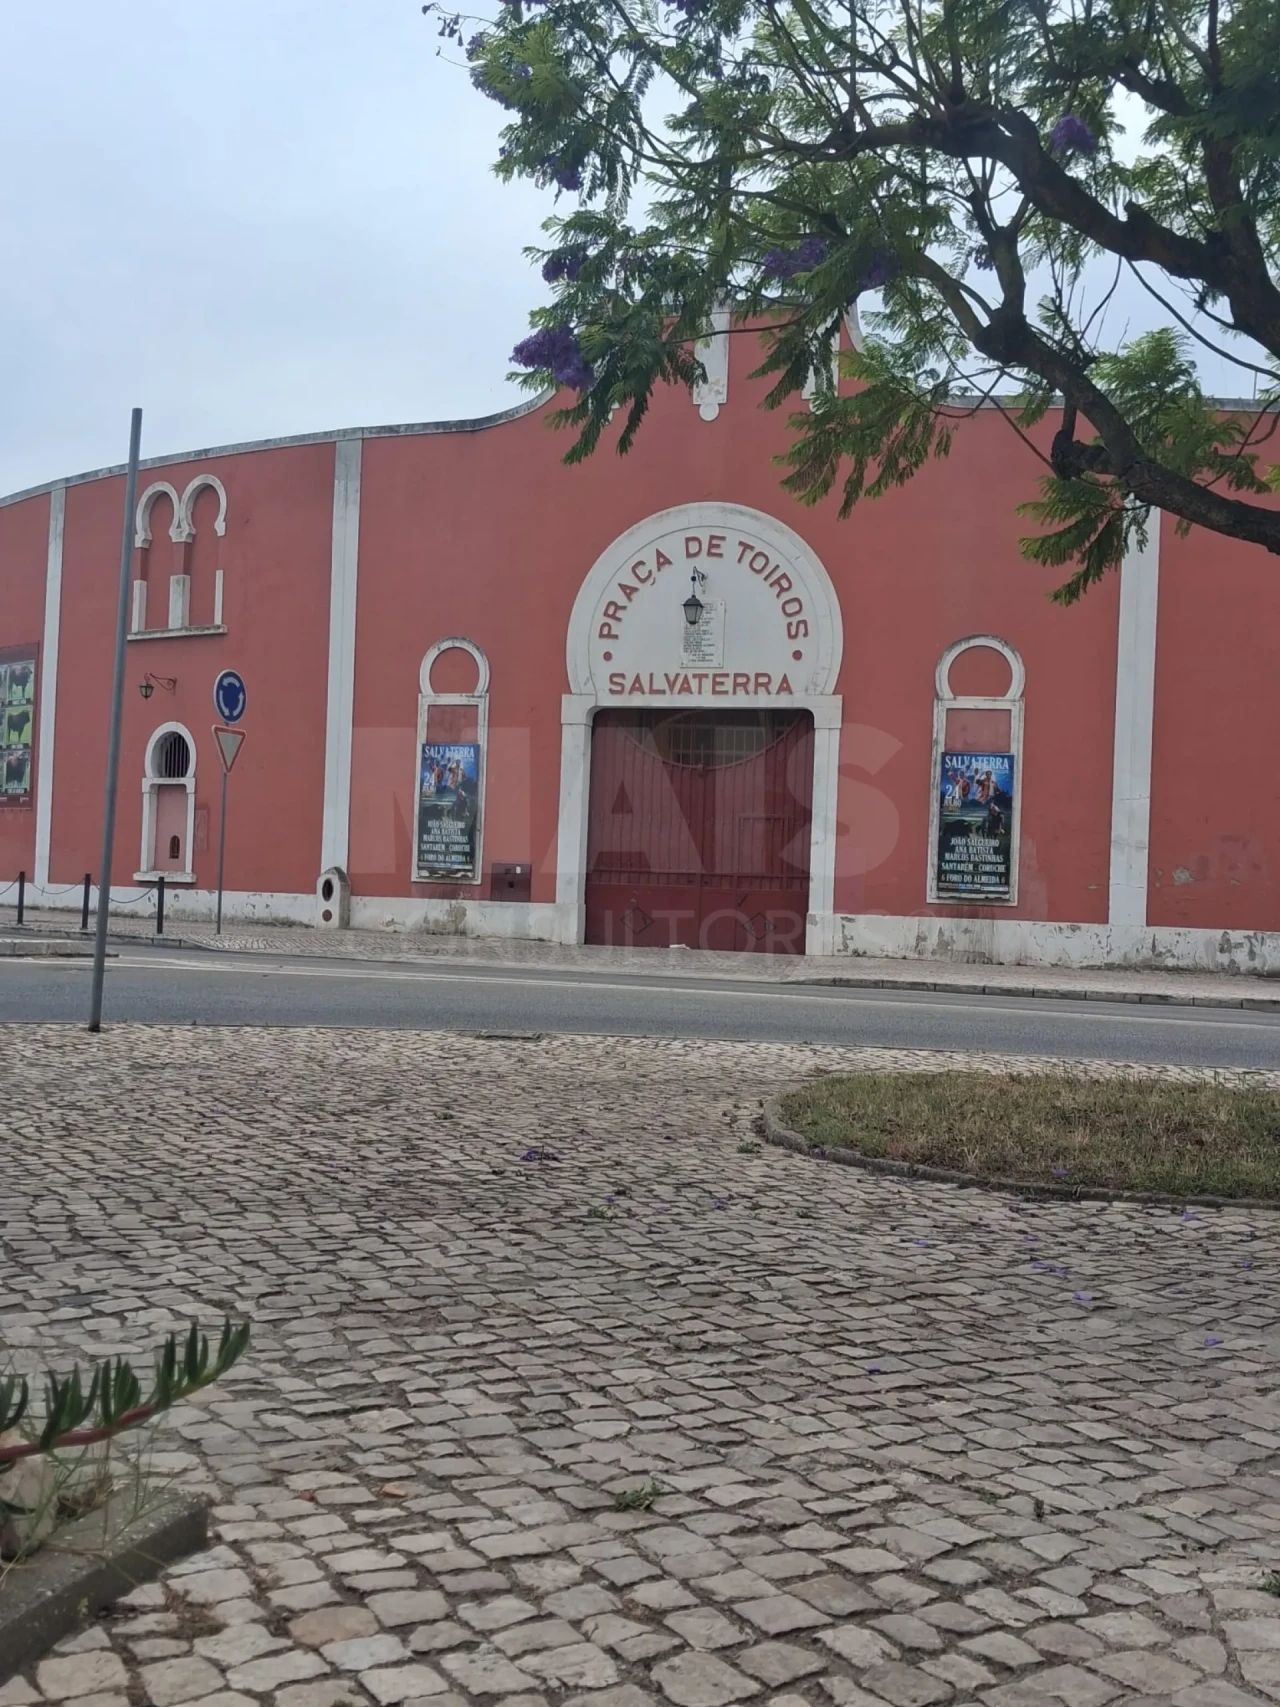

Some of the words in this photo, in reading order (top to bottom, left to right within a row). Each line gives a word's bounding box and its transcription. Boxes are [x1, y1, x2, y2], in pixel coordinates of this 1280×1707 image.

[599, 548, 673, 640] PRAÇA
[685, 534, 726, 559] DE
[737, 541, 809, 640] TOIROS
[608, 672, 793, 696] SALVATERRA
[424, 745, 475, 758] SALVATERRA
[945, 755, 1009, 769] SALVATERRA
[424, 772, 436, 787] 24
[945, 784, 959, 799] 24
[955, 846, 967, 854] ANA
[944, 853, 969, 861] MARCOS
[970, 854, 1004, 863] BASTINHAS
[978, 864, 1007, 873] CORUCHE
[946, 874, 962, 882] FORO
[963, 874, 972, 883] DO
[973, 875, 1000, 884] ALMEIDA
